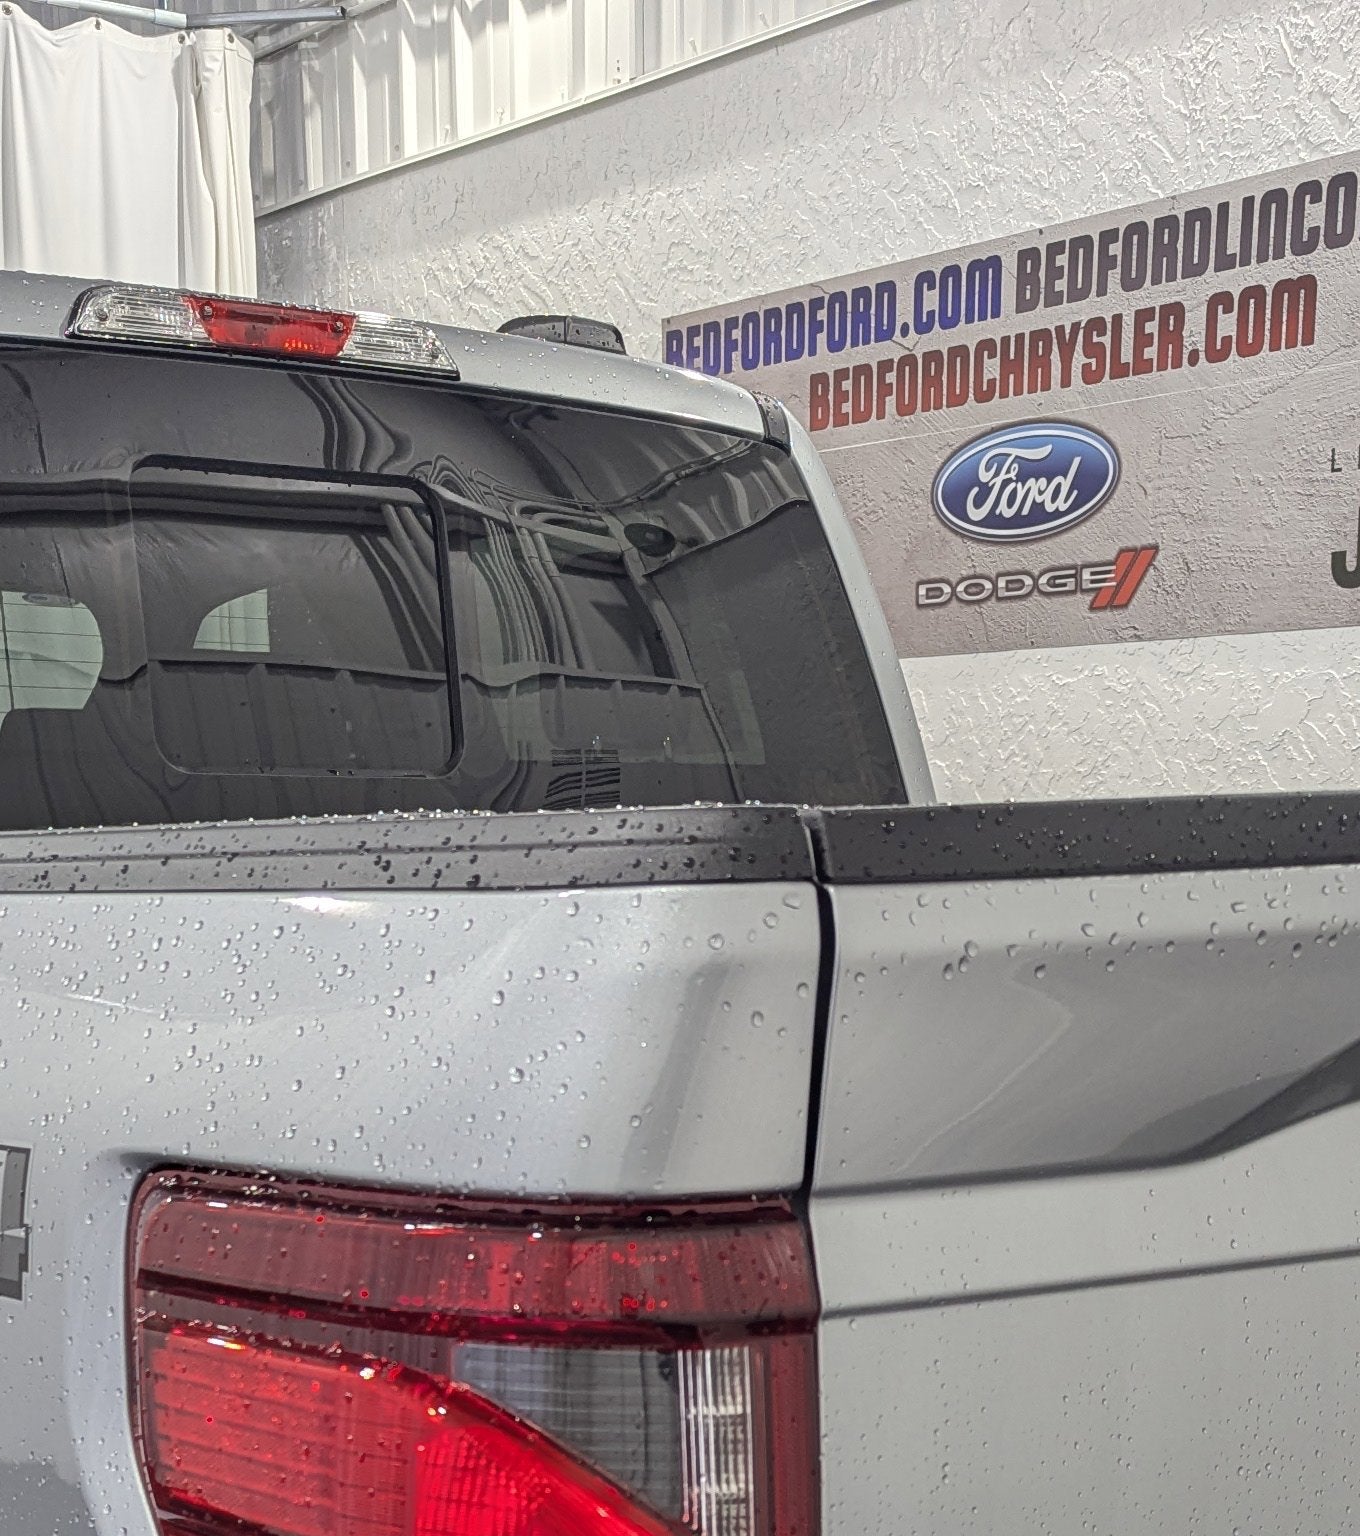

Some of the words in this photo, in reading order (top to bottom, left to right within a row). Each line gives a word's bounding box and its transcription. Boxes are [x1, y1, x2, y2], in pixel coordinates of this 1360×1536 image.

[665, 254, 1003, 377] BEDFORDFORD.COM
[809, 273, 1317, 432] BEDFORDCHRYSLER.COM
[966, 445, 1081, 519] Ford
[915, 564, 1119, 608] DODGE
